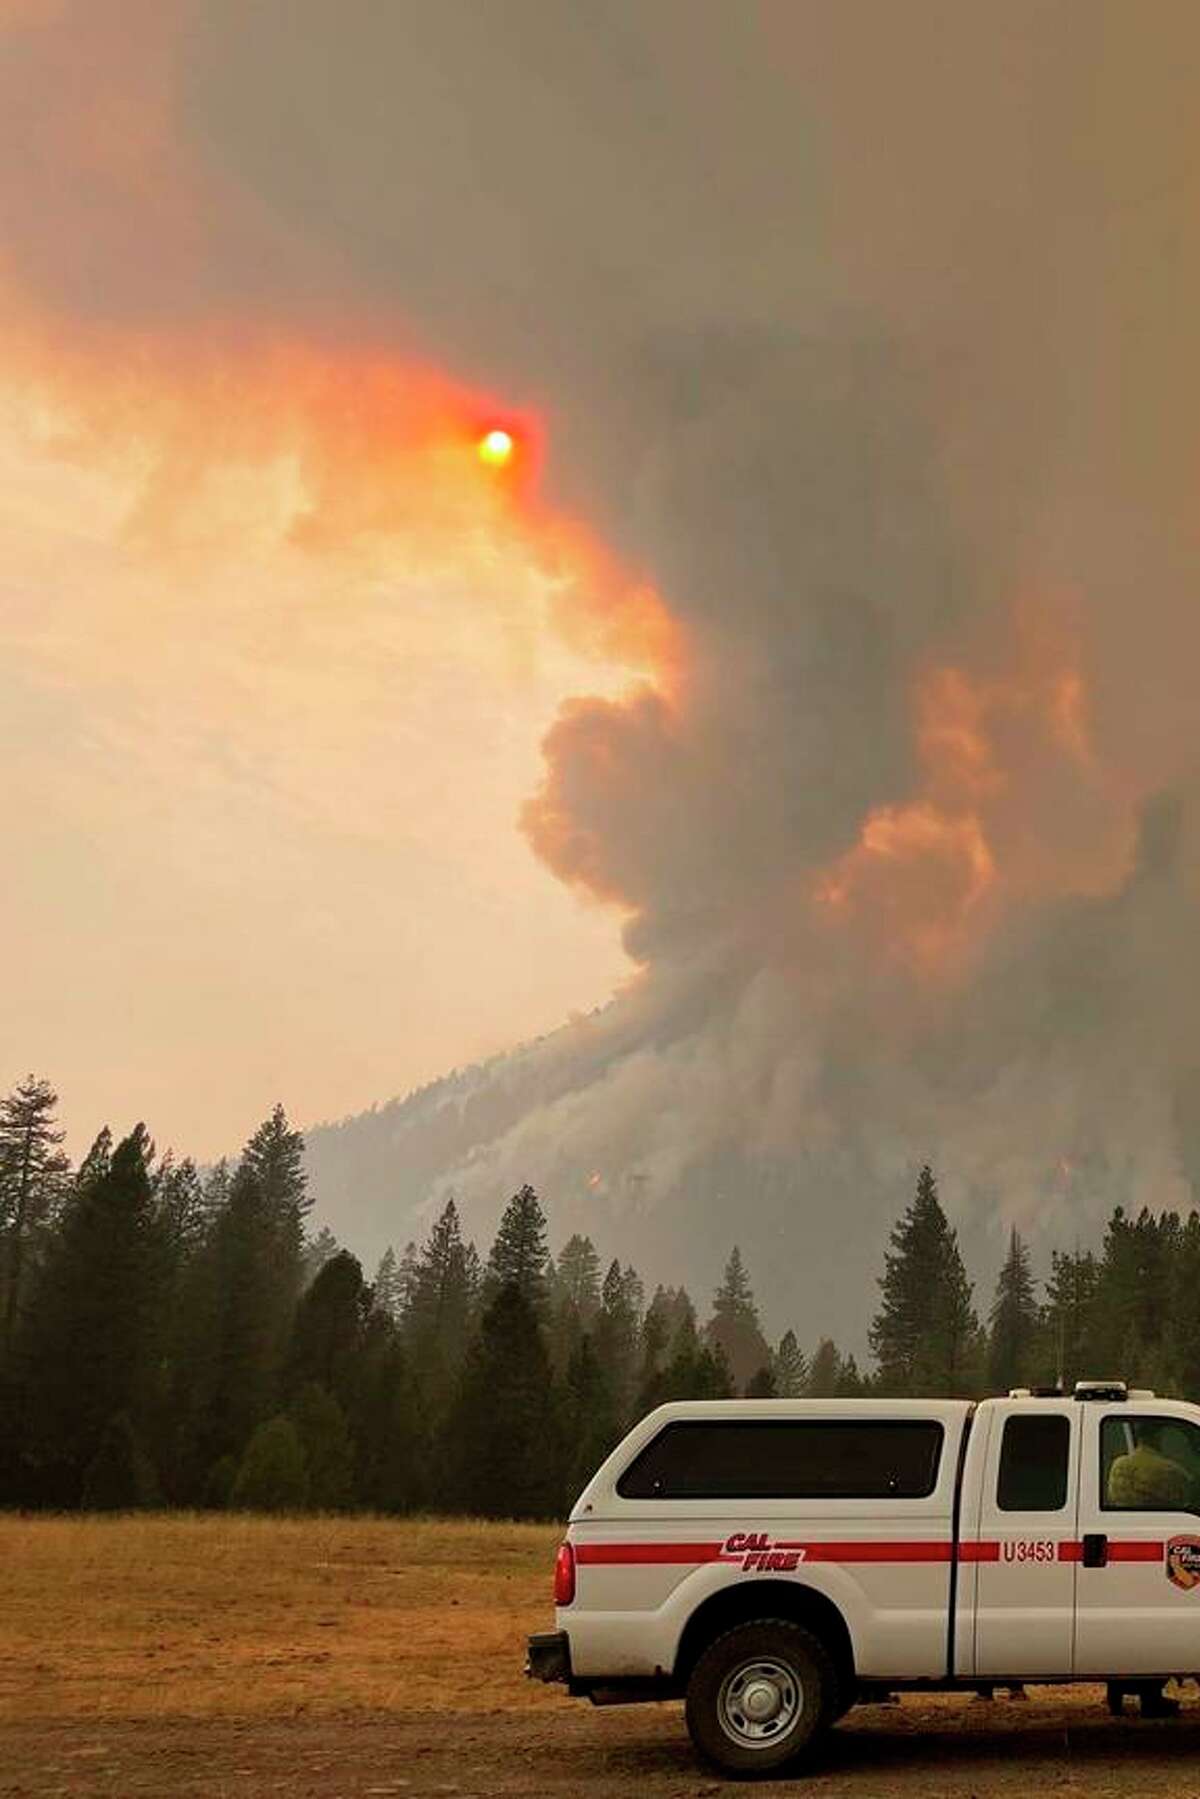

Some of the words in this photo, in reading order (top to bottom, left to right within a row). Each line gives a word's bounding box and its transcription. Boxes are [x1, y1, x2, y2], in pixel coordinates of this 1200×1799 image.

[725, 1533, 772, 1552] CAL
[1004, 1541, 1054, 1562] U3453
[742, 1553, 801, 1572] FIRE
